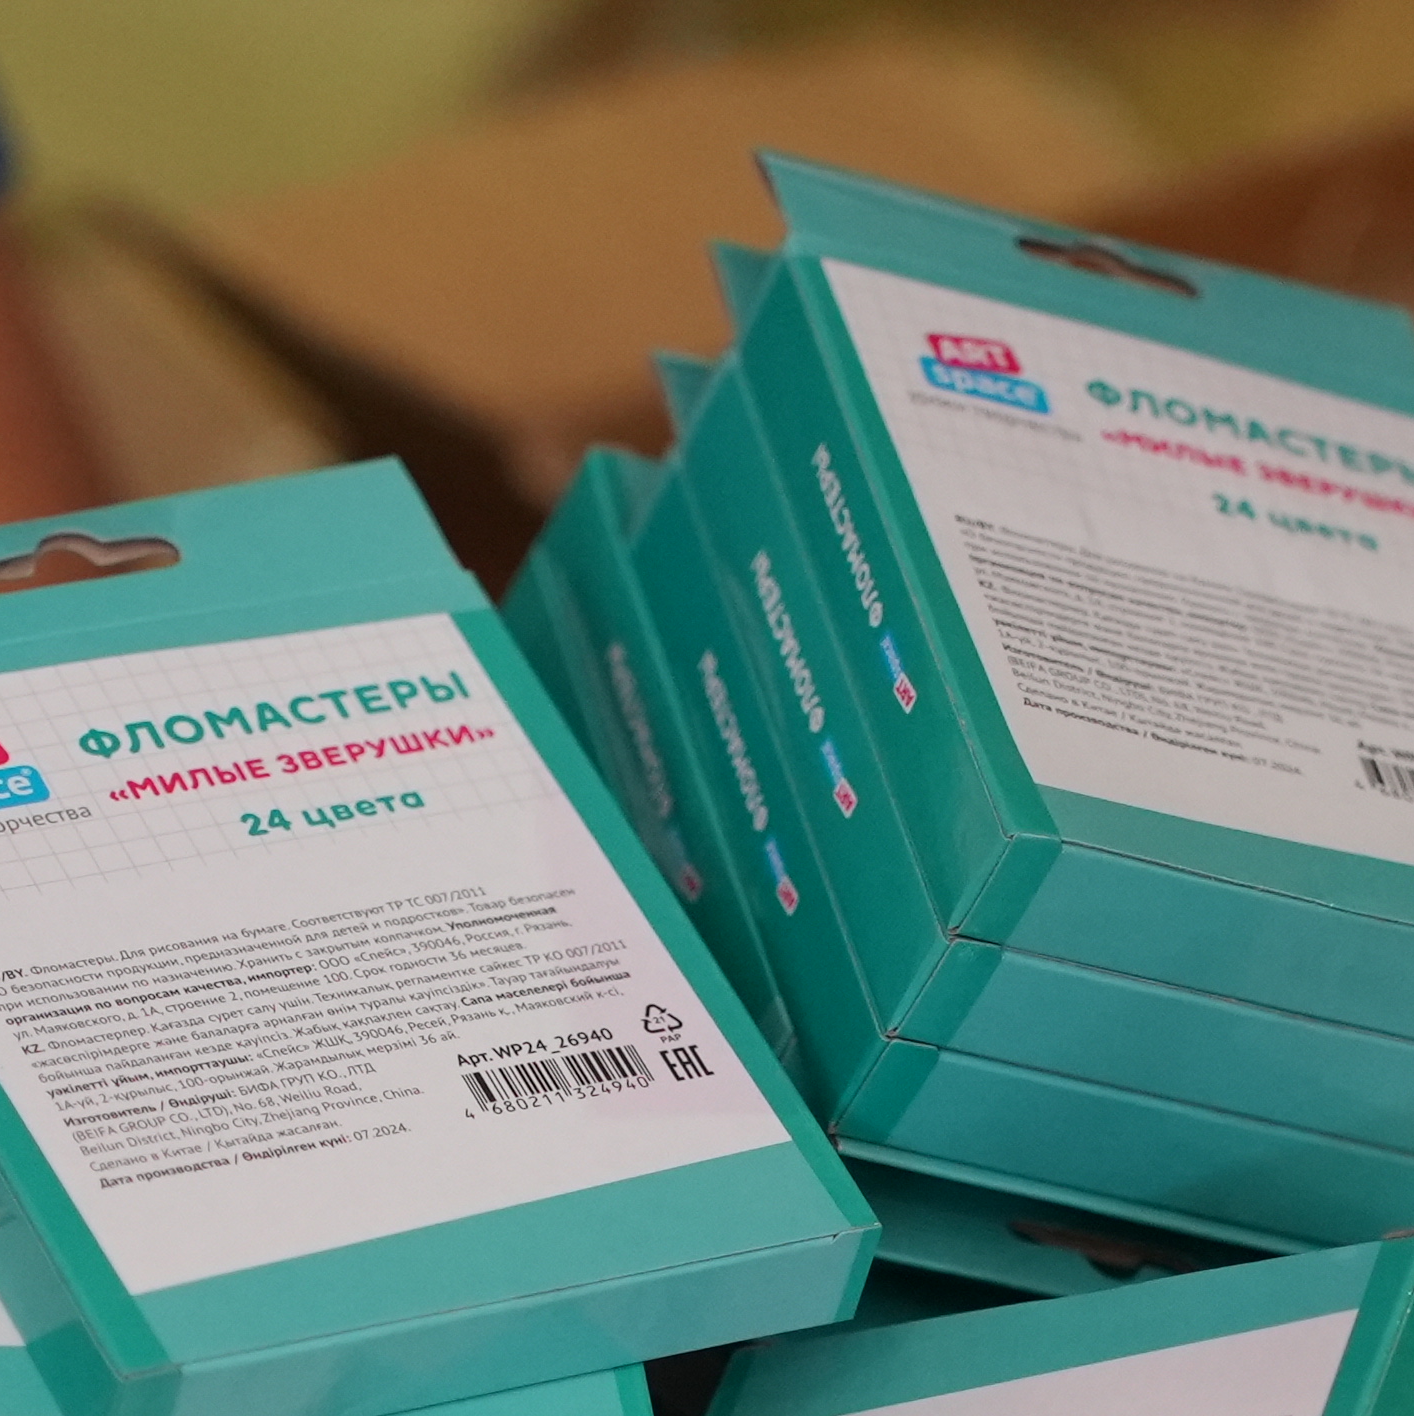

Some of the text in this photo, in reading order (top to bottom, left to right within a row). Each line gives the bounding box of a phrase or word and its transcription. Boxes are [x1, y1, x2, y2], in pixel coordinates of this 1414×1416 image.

[937, 336, 1011, 368] ART
[1212, 492, 1258, 521] 24
[79, 670, 471, 760] ФЛОМАСТЕРЫ
[108, 724, 495, 803] «МИЛЫЕ ЗВЕРУШКИ»
[240, 790, 425, 837] 24 цвета
[28, 954, 120, 976] Фломастеры.
[118, 948, 147, 963] Для
[147, 934, 221, 958] рисования
[220, 931, 240, 943] на
[239, 922, 292, 940] бумаге.
[289, 904, 386, 930] Соответствуют
[384, 899, 405, 912] ТР
[403, 895, 426, 909] ТС
[422, 885, 488, 906] 007/2011
[4, 1003, 94, 1028] организация
[93, 999, 114, 1011] по
[113, 987, 182, 1008] вопросам
[181, 976, 248, 996] качества,
[246, 963, 318, 984] импортер:
[317, 954, 352, 971] ООО
[409, 934, 467, 954] 390046,
[463, 928, 516, 944] Россия,
[456, 1027, 614, 1069] Арт. WP24_26940
[659, 1033, 683, 1044] PAP
[71, 1124, 119, 1145] (BEIFA
[117, 1114, 168, 1134] GROUP
[231, 1101, 258, 1114] No.
[256, 1095, 282, 1109] 68,
[277, 1088, 323, 1105] Weiliu
[321, 1080, 364, 1097] Road,
[78, 1086, 426, 1158] Beilun District, Ningbo City, Zhejiang Province, China.
